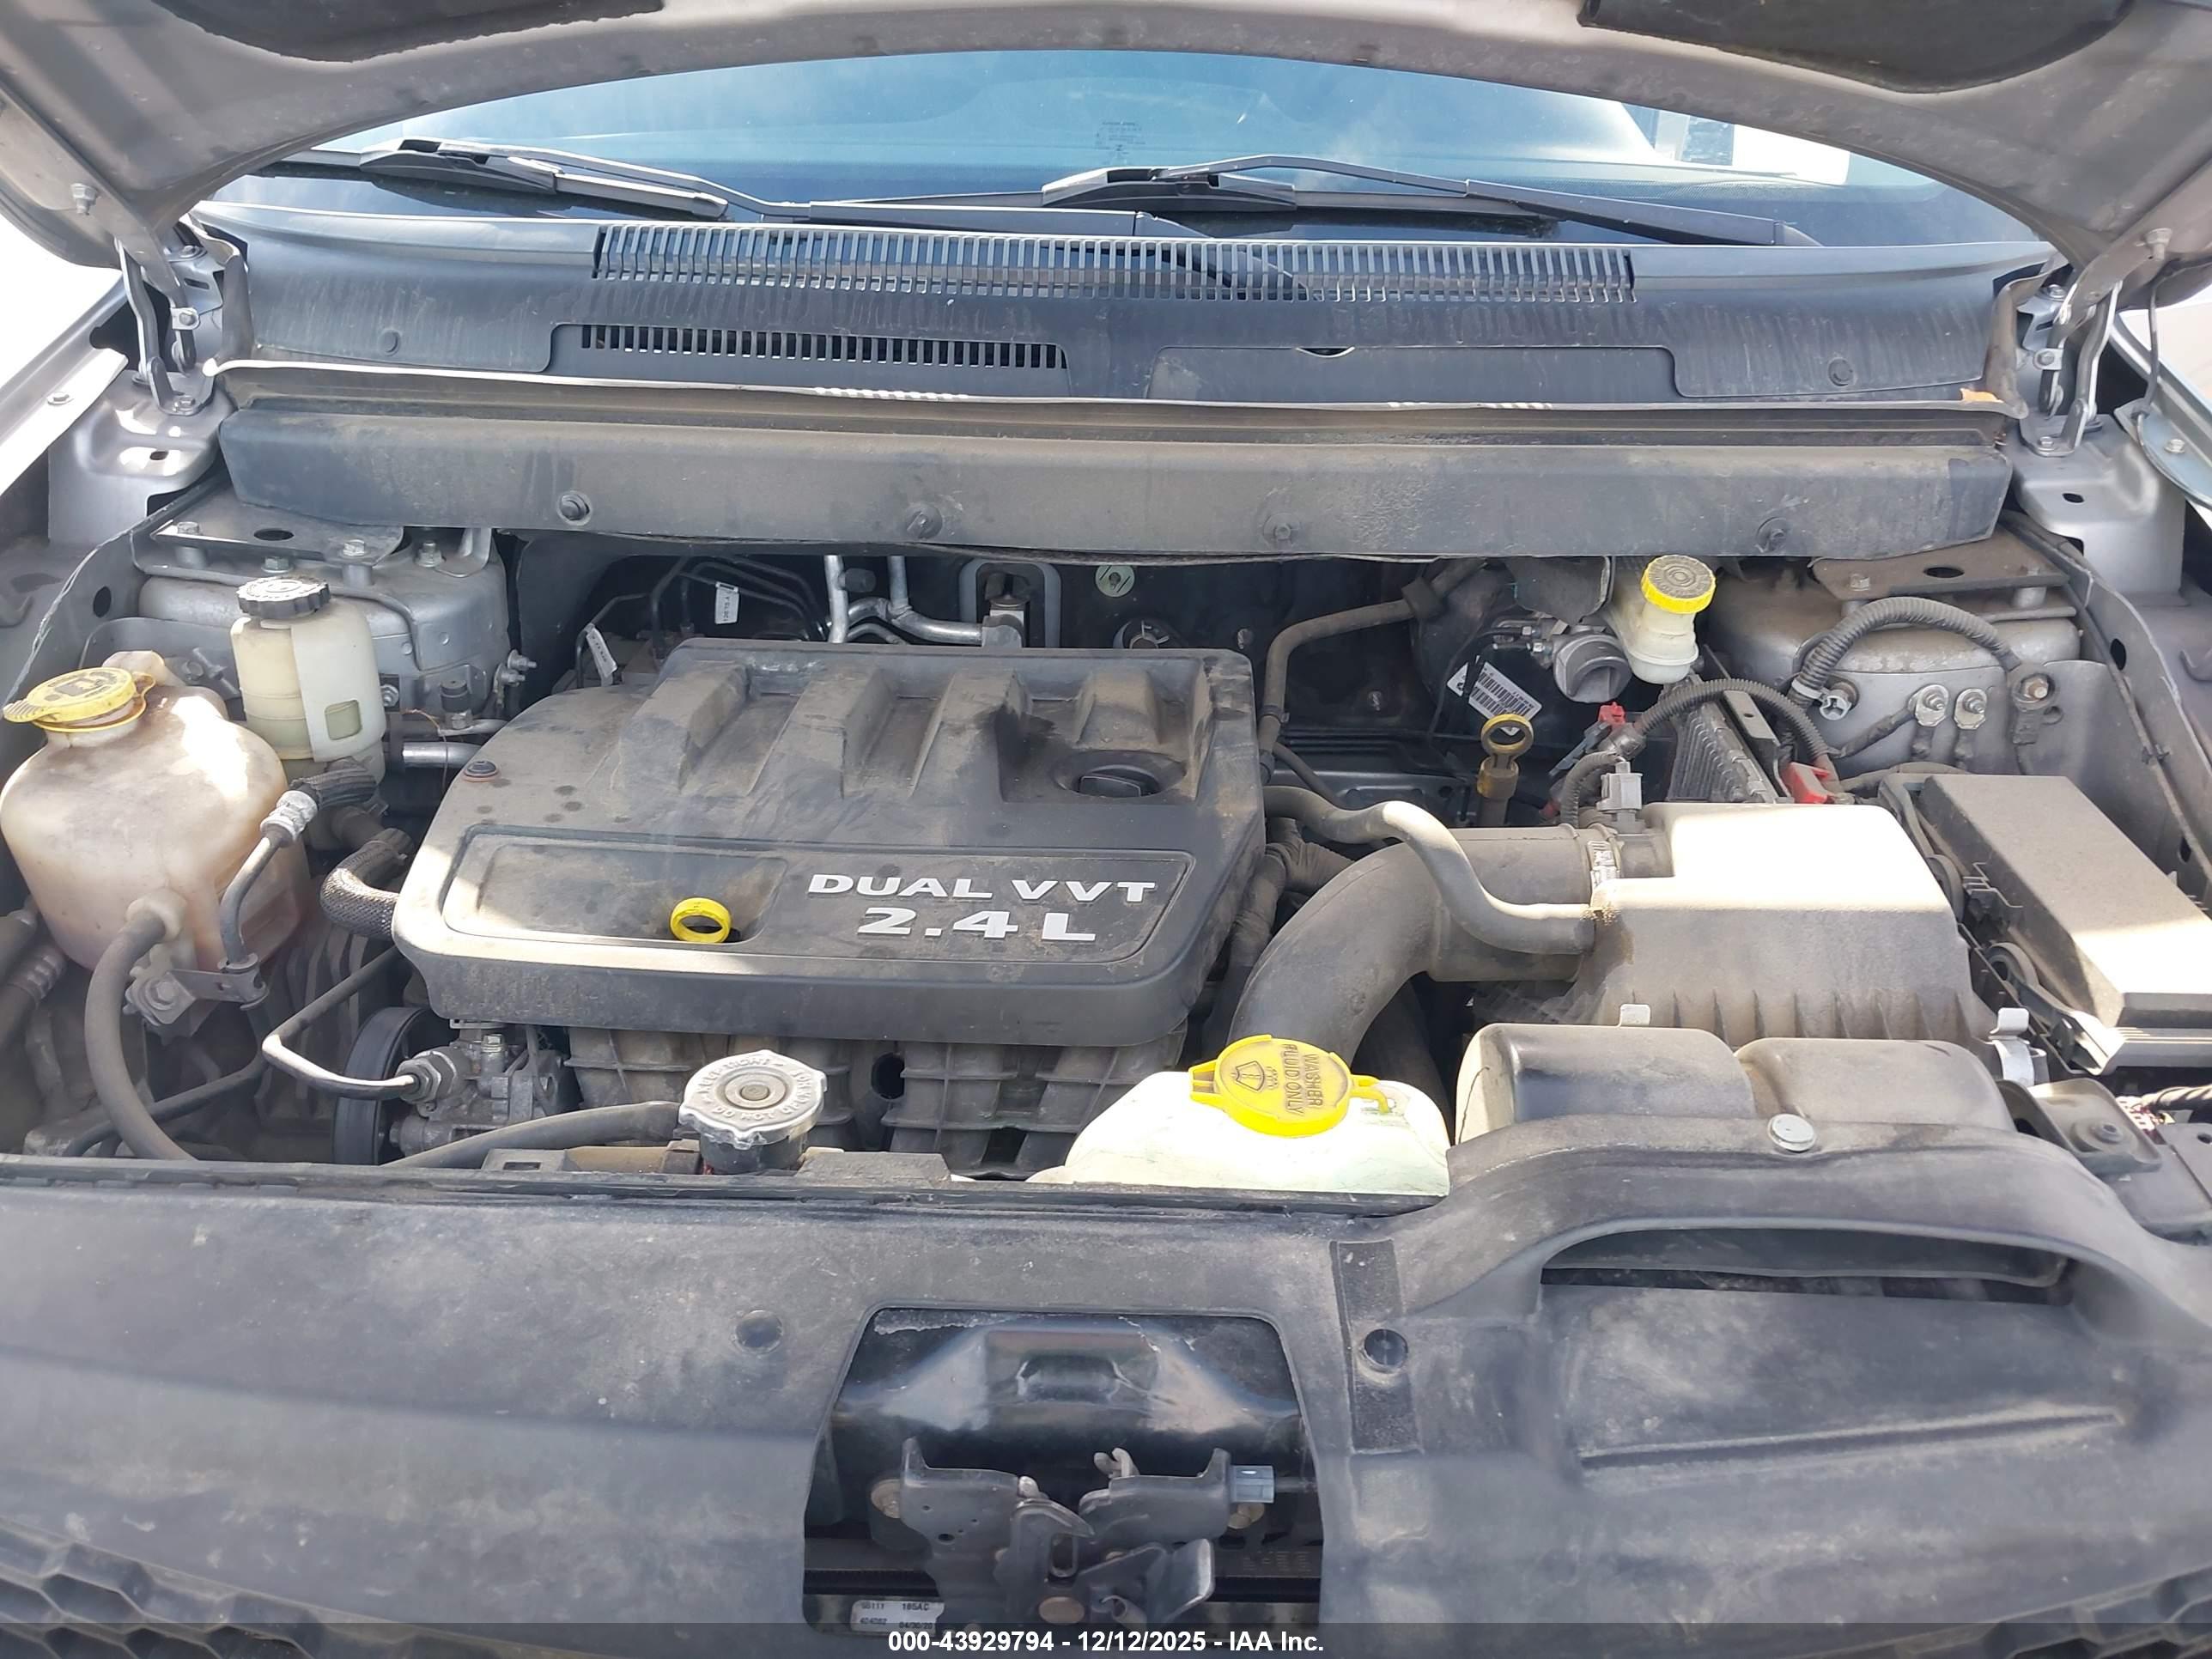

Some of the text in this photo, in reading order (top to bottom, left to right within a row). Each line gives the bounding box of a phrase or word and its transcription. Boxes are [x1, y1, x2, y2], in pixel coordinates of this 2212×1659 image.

[807, 873, 1156, 902] DUAL VVT
[1282, 1043, 1305, 1115] FLUID ONLY
[1303, 1053, 1324, 1109] WASHER
[712, 1106, 736, 1117] DO
[741, 1111, 776, 1121] NOT
